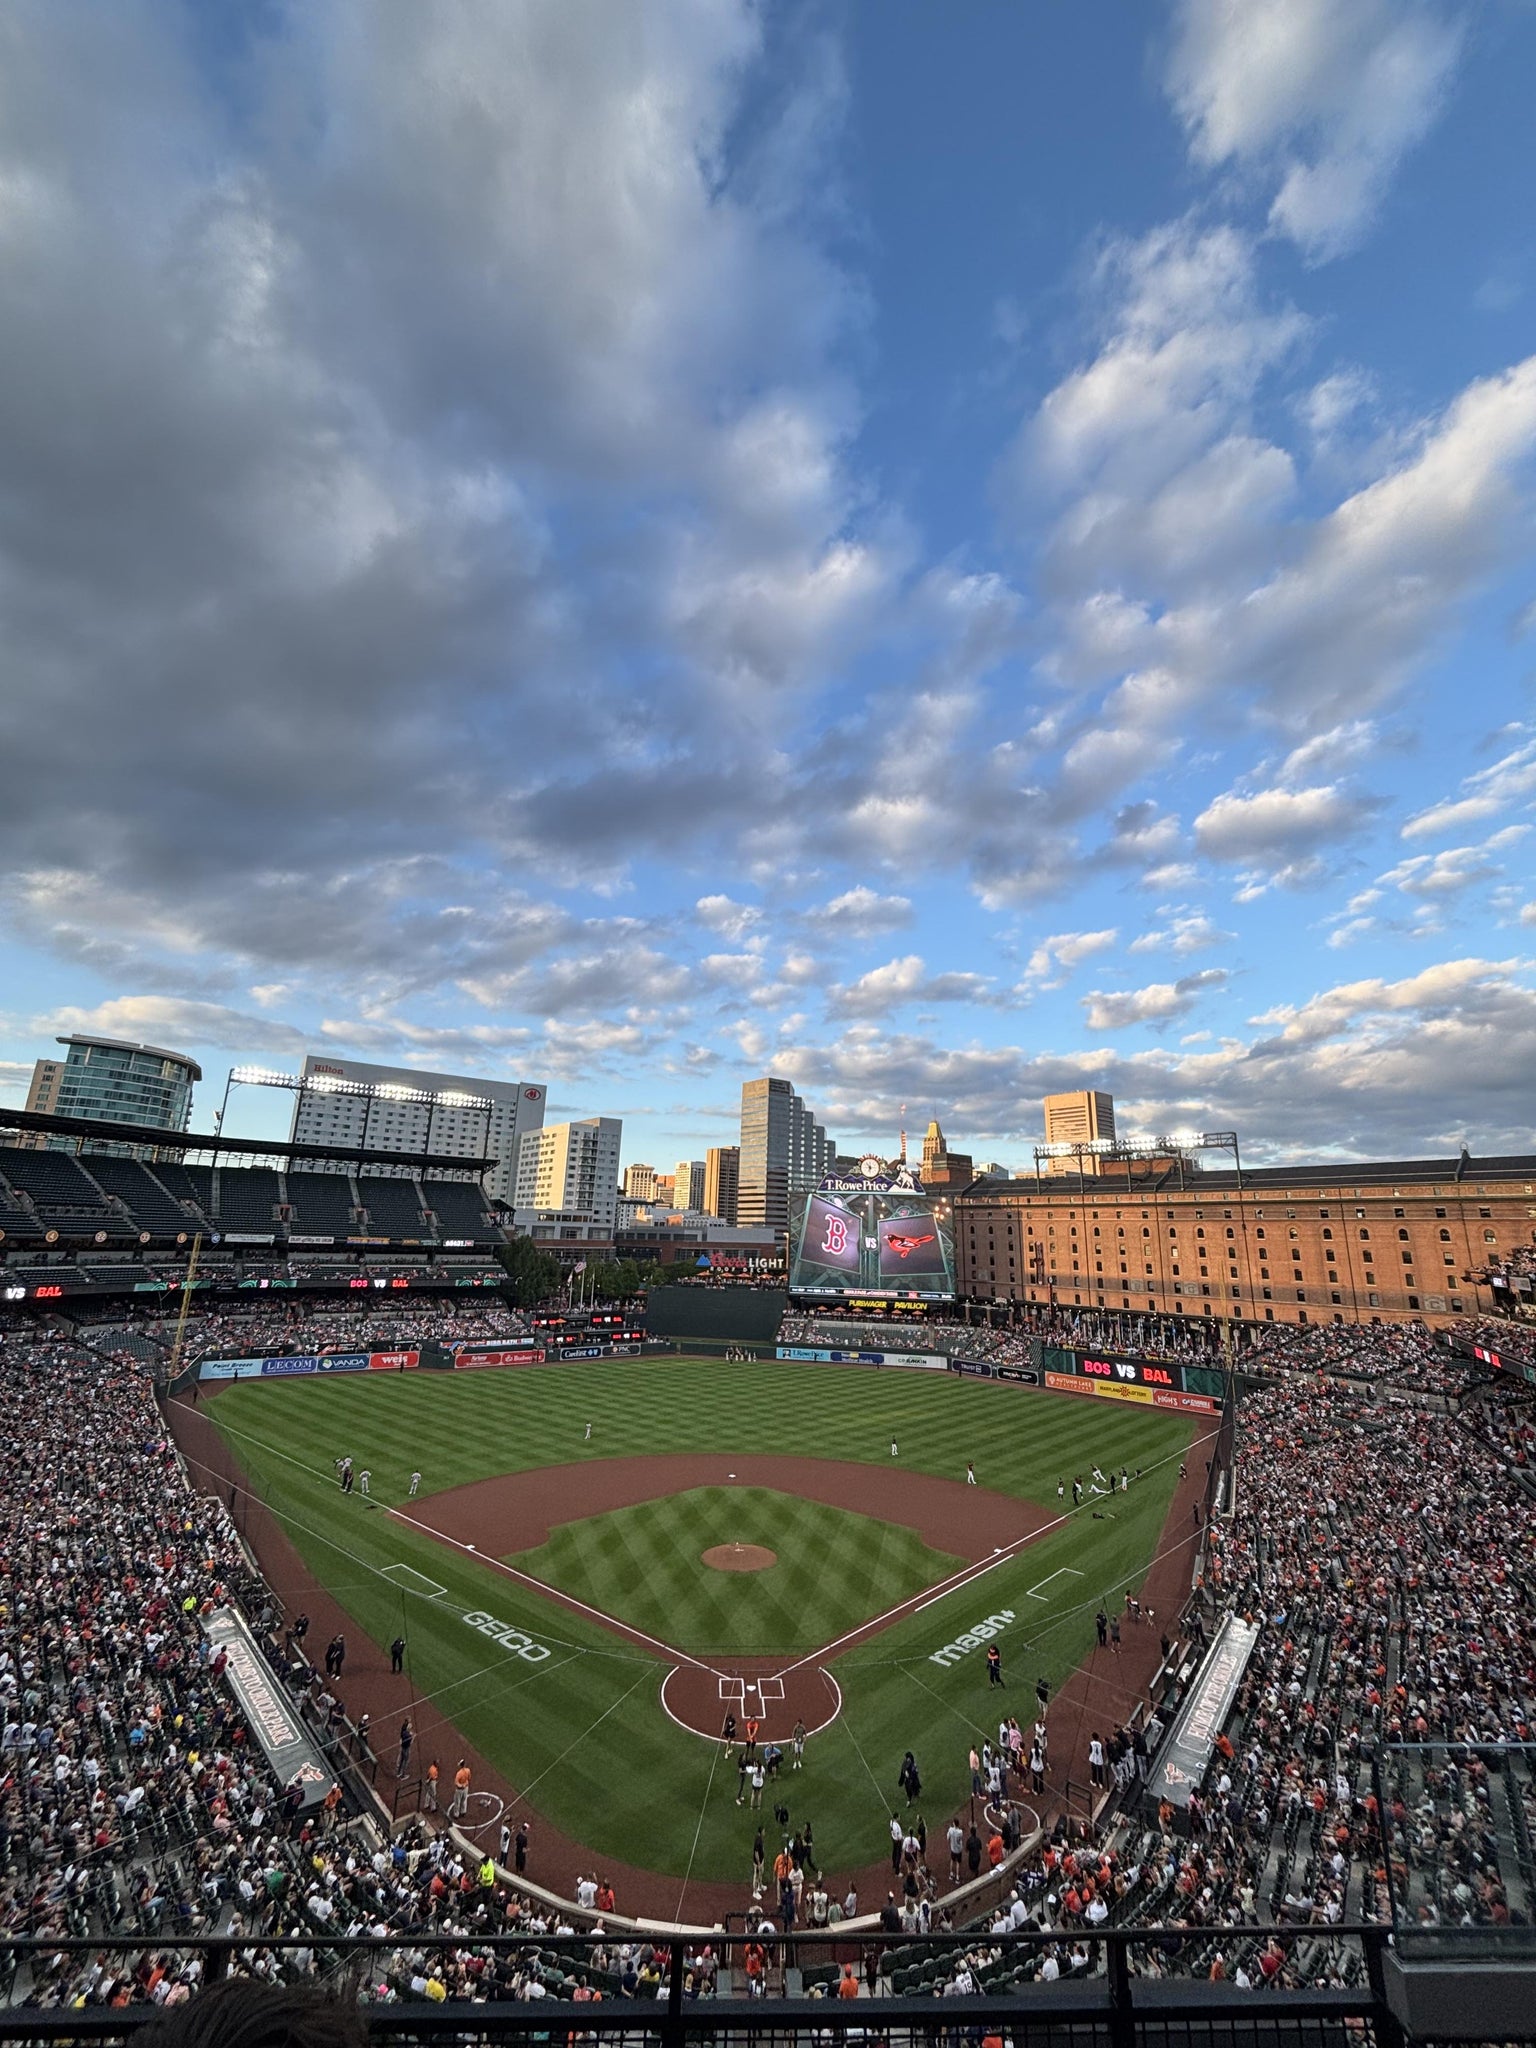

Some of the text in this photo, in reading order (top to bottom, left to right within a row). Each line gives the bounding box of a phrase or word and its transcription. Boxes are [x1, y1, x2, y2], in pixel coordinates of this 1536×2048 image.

[314, 1064, 344, 1075] Hilton
[863, 1180, 888, 1191] Price
[865, 1236, 877, 1249] VS
[711, 1253, 784, 1268] Coors LIGHT
[350, 1279, 409, 1288] BOS VS BAL
[5, 1286, 63, 1299] VS BAL
[849, 1300, 928, 1310] PUREWAGER PAVILION
[266, 1360, 313, 1370] LECOM
[333, 1358, 365, 1366] VANDA
[381, 1354, 408, 1364] weis
[1083, 1360, 1172, 1384] BOS VS BAL
[1055, 1377, 1078, 1385] AUTUMN
[1157, 1393, 1178, 1406] HIGH'S
[462, 1611, 552, 1662] GEICO
[226, 1641, 258, 1680] WELCOME
[1211, 1653, 1237, 1685] ORIOLES
[1204, 1681, 1226, 1701] THE
[248, 1685, 282, 1720] ORIOLE
[263, 1715, 294, 1745] PARK
[1187, 1711, 1215, 1740] HOME
